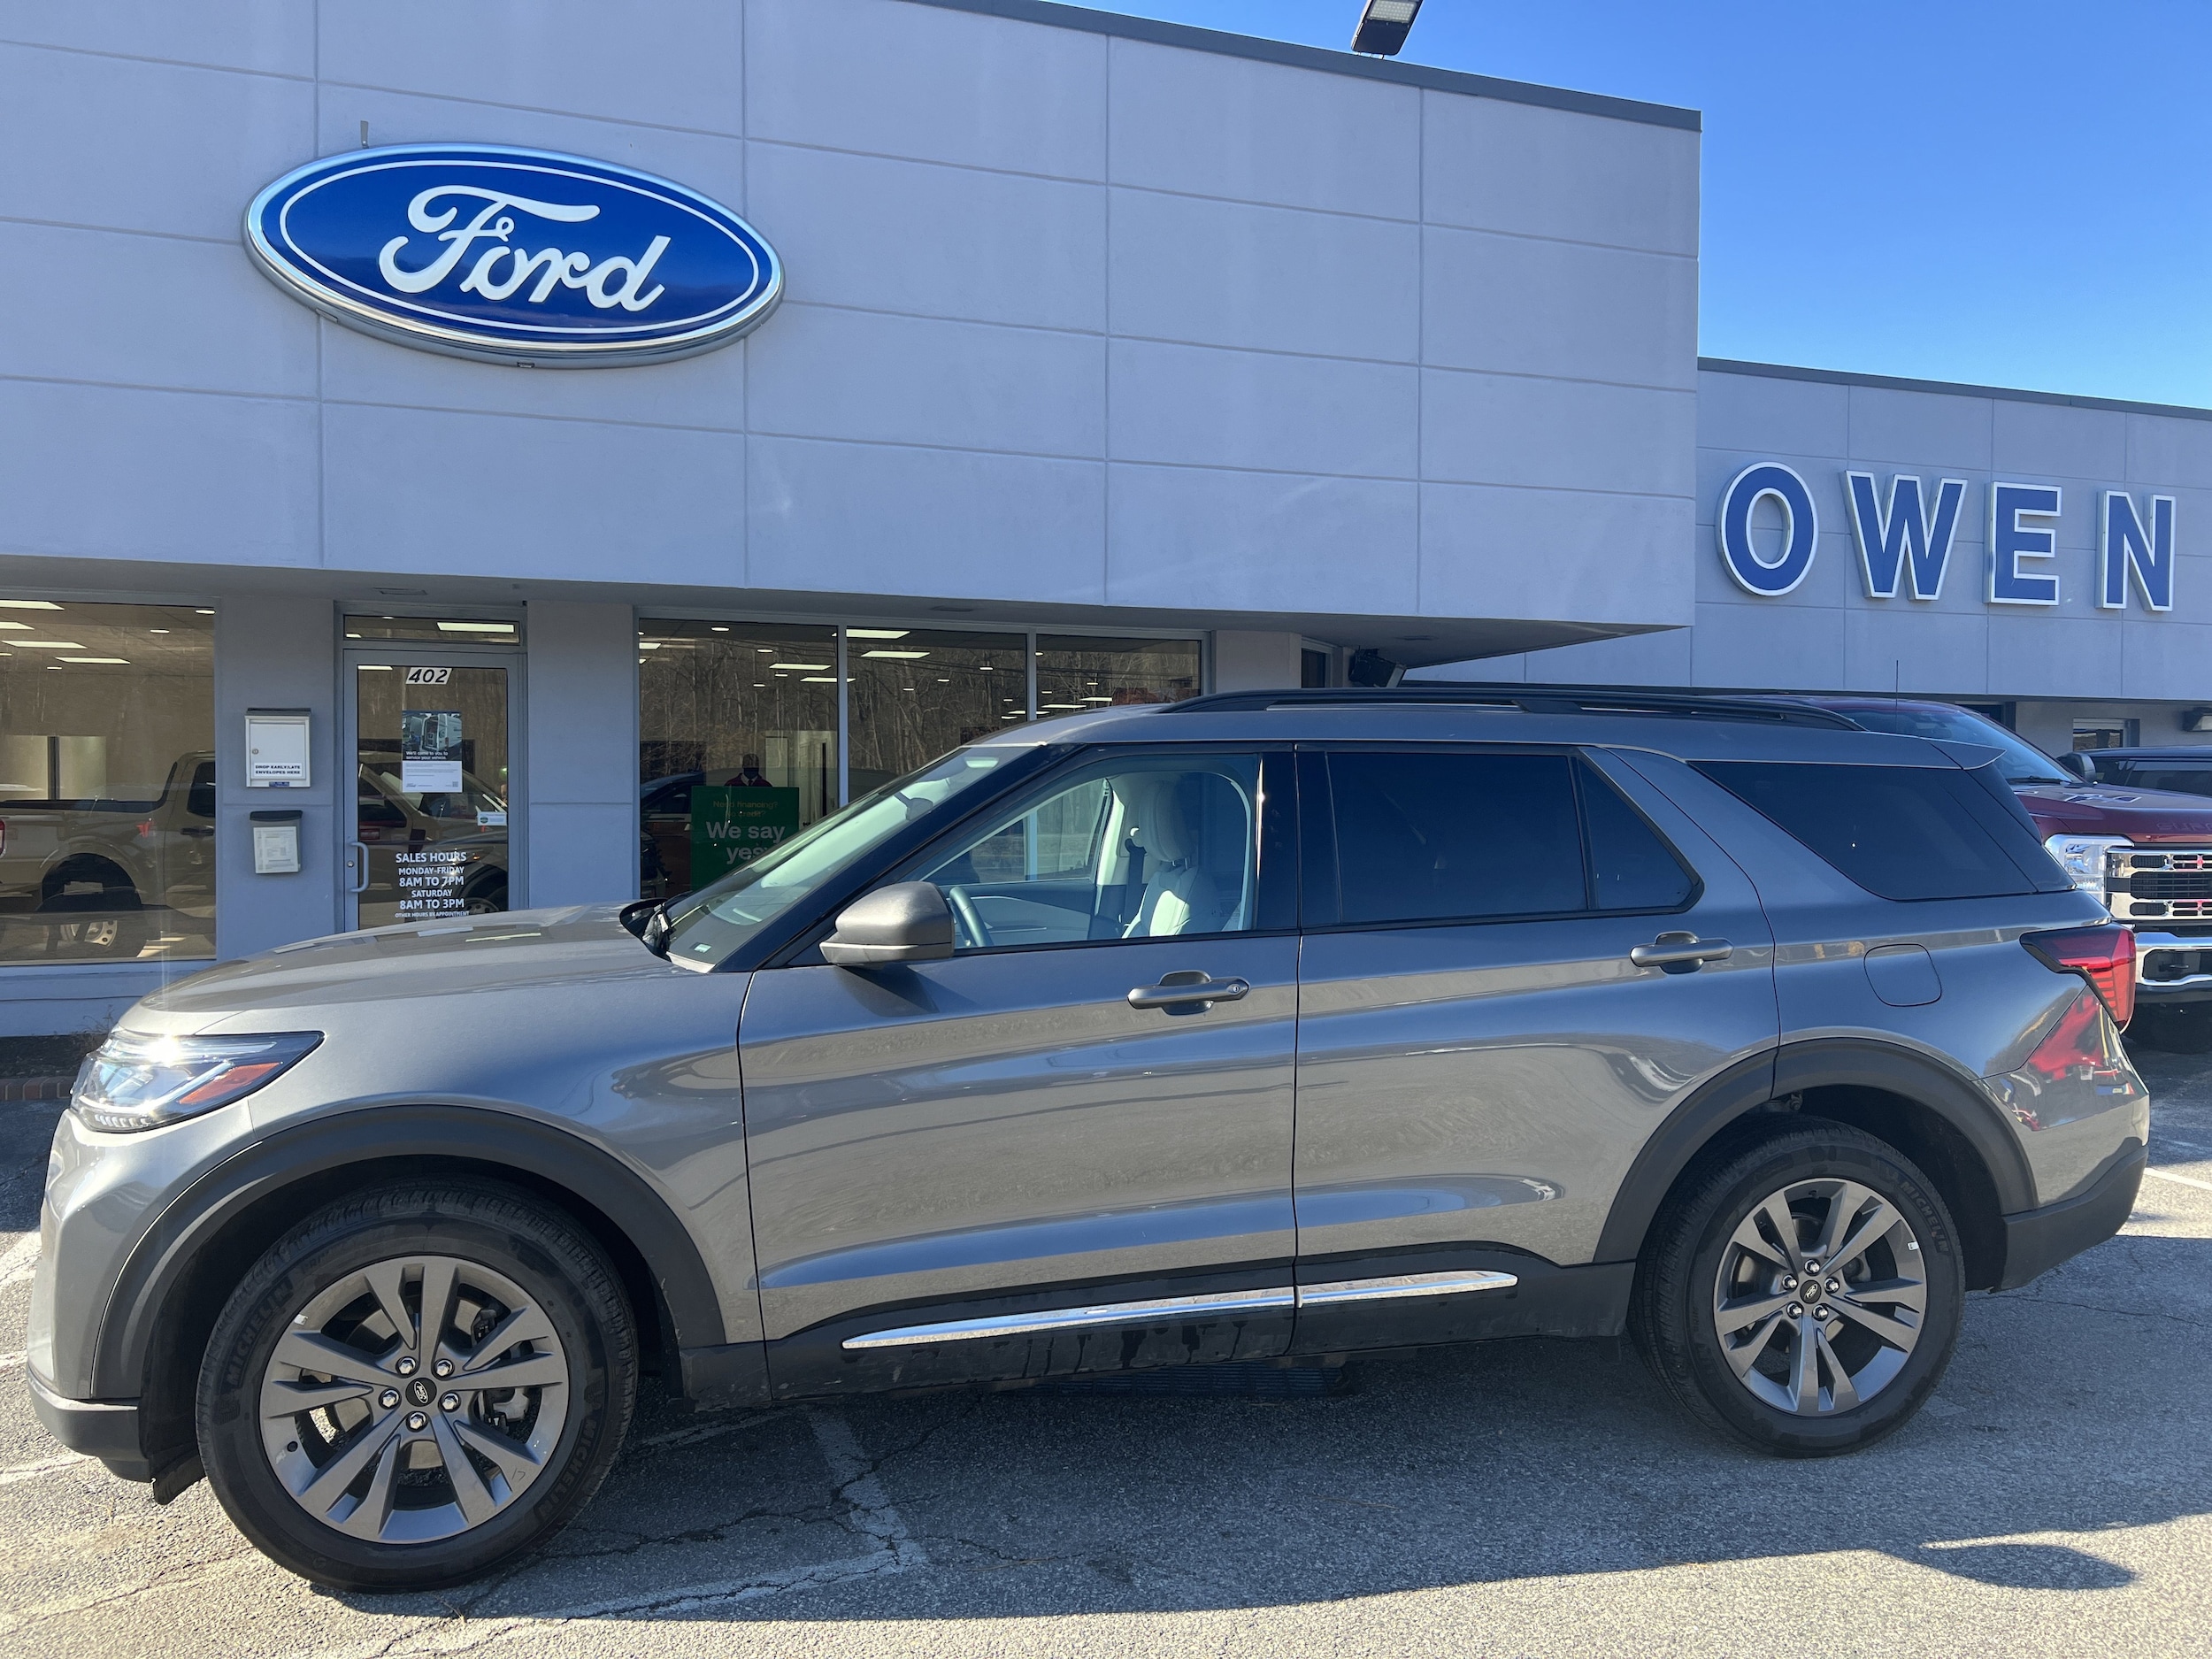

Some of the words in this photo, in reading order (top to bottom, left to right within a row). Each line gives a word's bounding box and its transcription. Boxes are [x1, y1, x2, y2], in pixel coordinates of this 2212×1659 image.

[379, 185, 671, 312] Ford
[1716, 461, 2177, 611] OWEN
[408, 669, 448, 683] 402
[706, 821, 741, 839] We
[748, 826, 786, 843] say
[396, 852, 427, 863] SALES
[429, 851, 467, 862] HOURS
[398, 866, 465, 875] MONDAY-FRIDAY
[399, 877, 422, 887] 8AM
[425, 876, 439, 886] TO
[442, 876, 465, 886] 7PM
[411, 889, 453, 898] SATURDAY
[399, 899, 423, 910] 8AM
[425, 899, 440, 909] TO
[442, 898, 465, 909] 3PM
[226, 1282, 288, 1386] MICHELIN
[538, 1419, 596, 1518] MICHELIN
